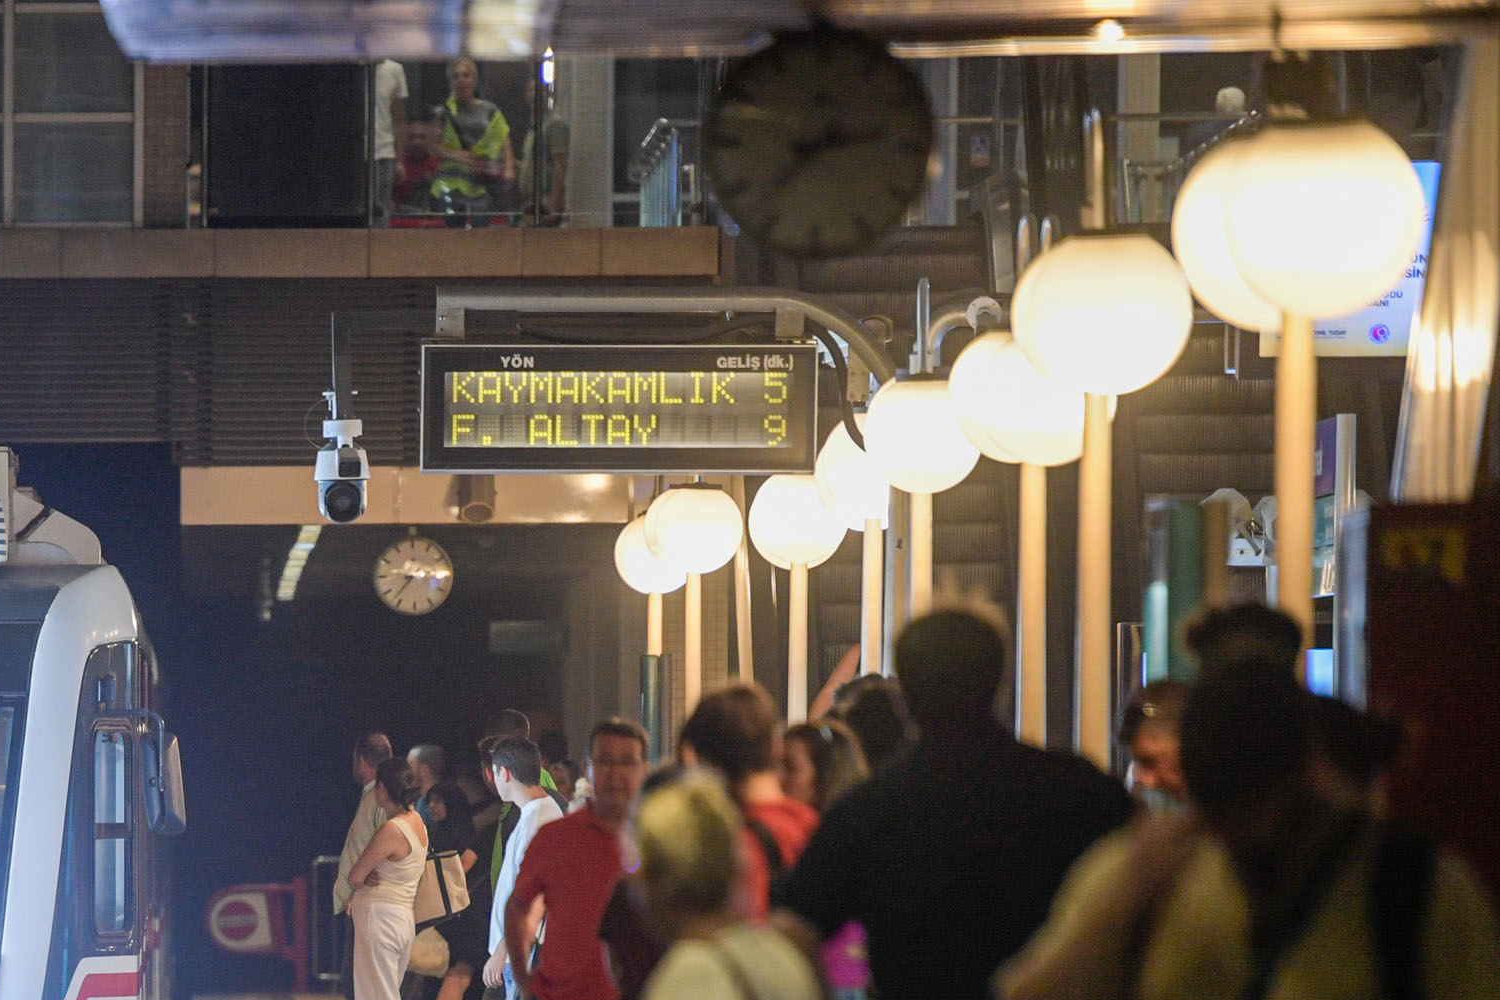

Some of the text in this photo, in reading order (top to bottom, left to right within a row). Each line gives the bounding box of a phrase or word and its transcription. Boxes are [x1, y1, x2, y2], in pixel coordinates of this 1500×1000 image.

[500, 354, 794, 371] YÖN GELİŞ (dk.)
[452, 371, 788, 404] KAYMAKAMLIK 5
[451, 414, 788, 446] F. ALTAY 9
